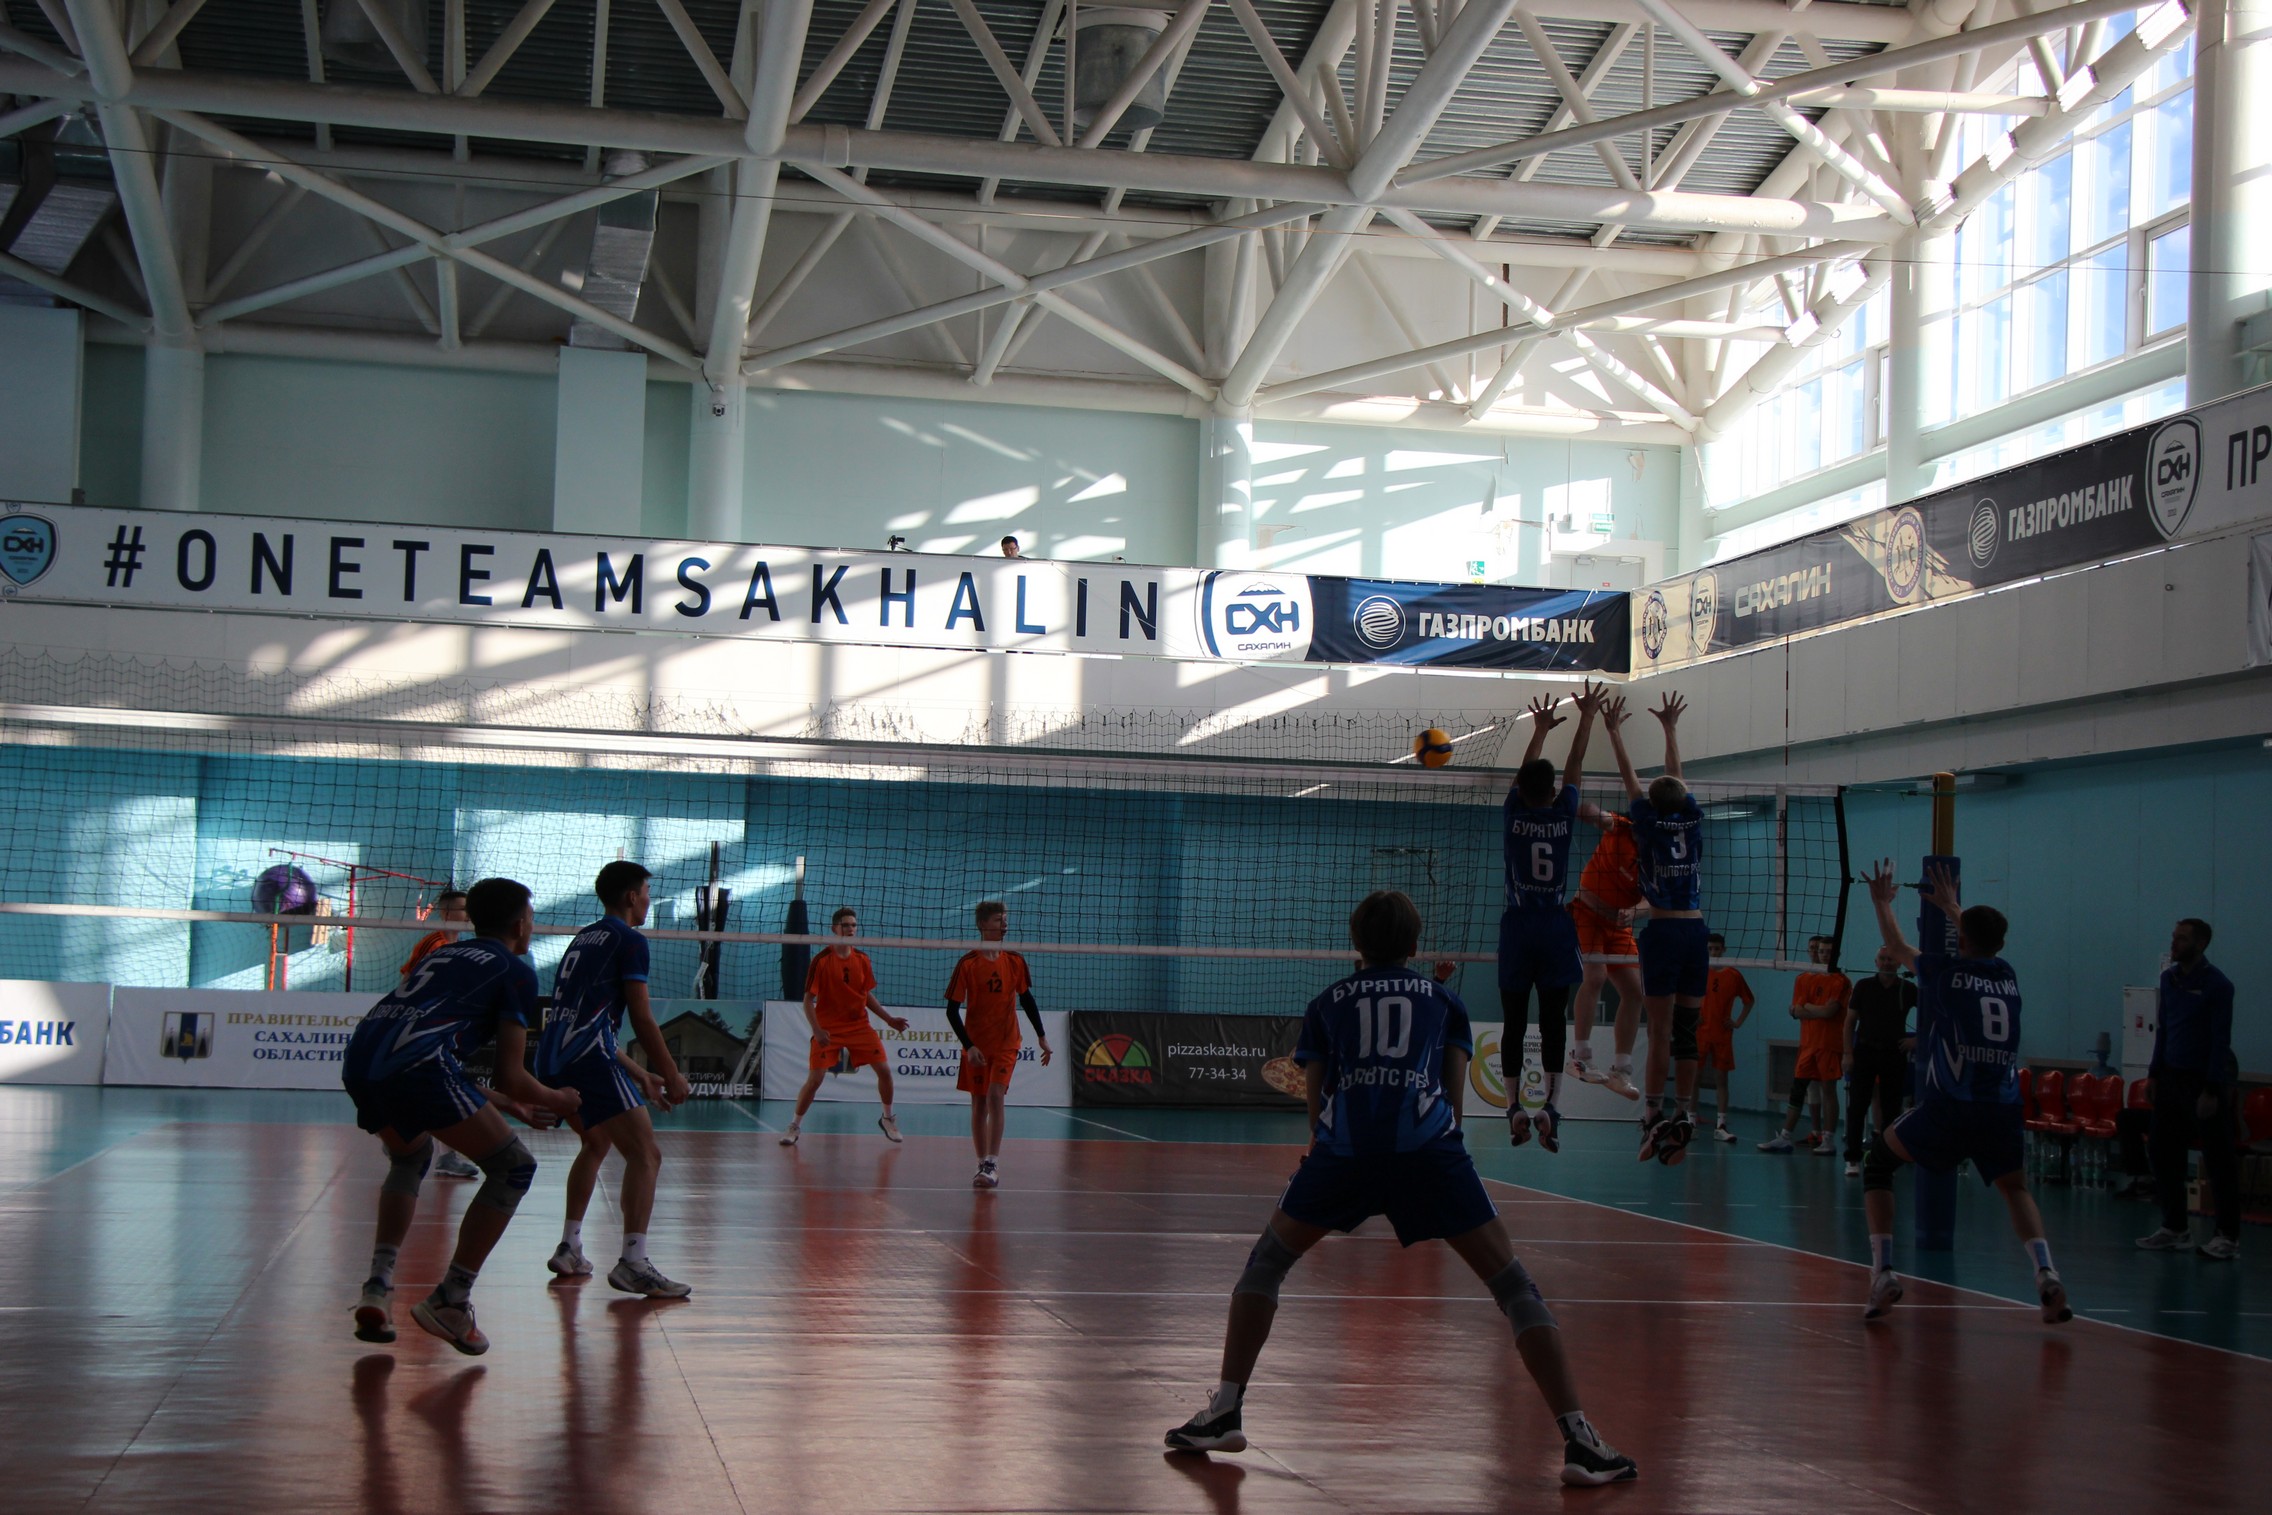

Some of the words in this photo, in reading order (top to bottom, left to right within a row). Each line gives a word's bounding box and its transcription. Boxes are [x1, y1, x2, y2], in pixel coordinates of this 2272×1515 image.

[2008, 474, 2134, 542] ГАЗПРОМБАНК
[1735, 562, 1832, 618] САХАЛИН
[1417, 610, 1595, 643] ГАЗПРОМБАНК
[1237, 642, 1291, 651] САХАЛИН
[1511, 819, 1568, 838] БУРЯТИЯ
[1531, 842, 1553, 881] 6
[394, 957, 453, 998] 5
[986, 979, 1002, 992] 12
[1951, 972, 2018, 996] БУРЯТИЯ
[1332, 978, 1432, 1004] БУРЯТИЯ
[227, 1013, 364, 1028] ПРАВИТЕЛЬСТ
[1355, 996, 1412, 1059] 10
[1980, 996, 2009, 1042] 8
[255, 1031, 352, 1044] САХАЛИН
[253, 1048, 343, 1061] ОБЛАСТИ
[1168, 1043, 1266, 1058] pizzaskazka.ru
[1957, 1044, 2009, 1066] РЦПВТС
[897, 1064, 960, 1077] ОБЛАС
[1084, 1068, 1153, 1084] СКАЗКА
[1188, 1067, 1246, 1081] 77-34-34
[1404, 1069, 1430, 1089] РБ
[688, 1083, 754, 1096] УДУЩЕЕ
